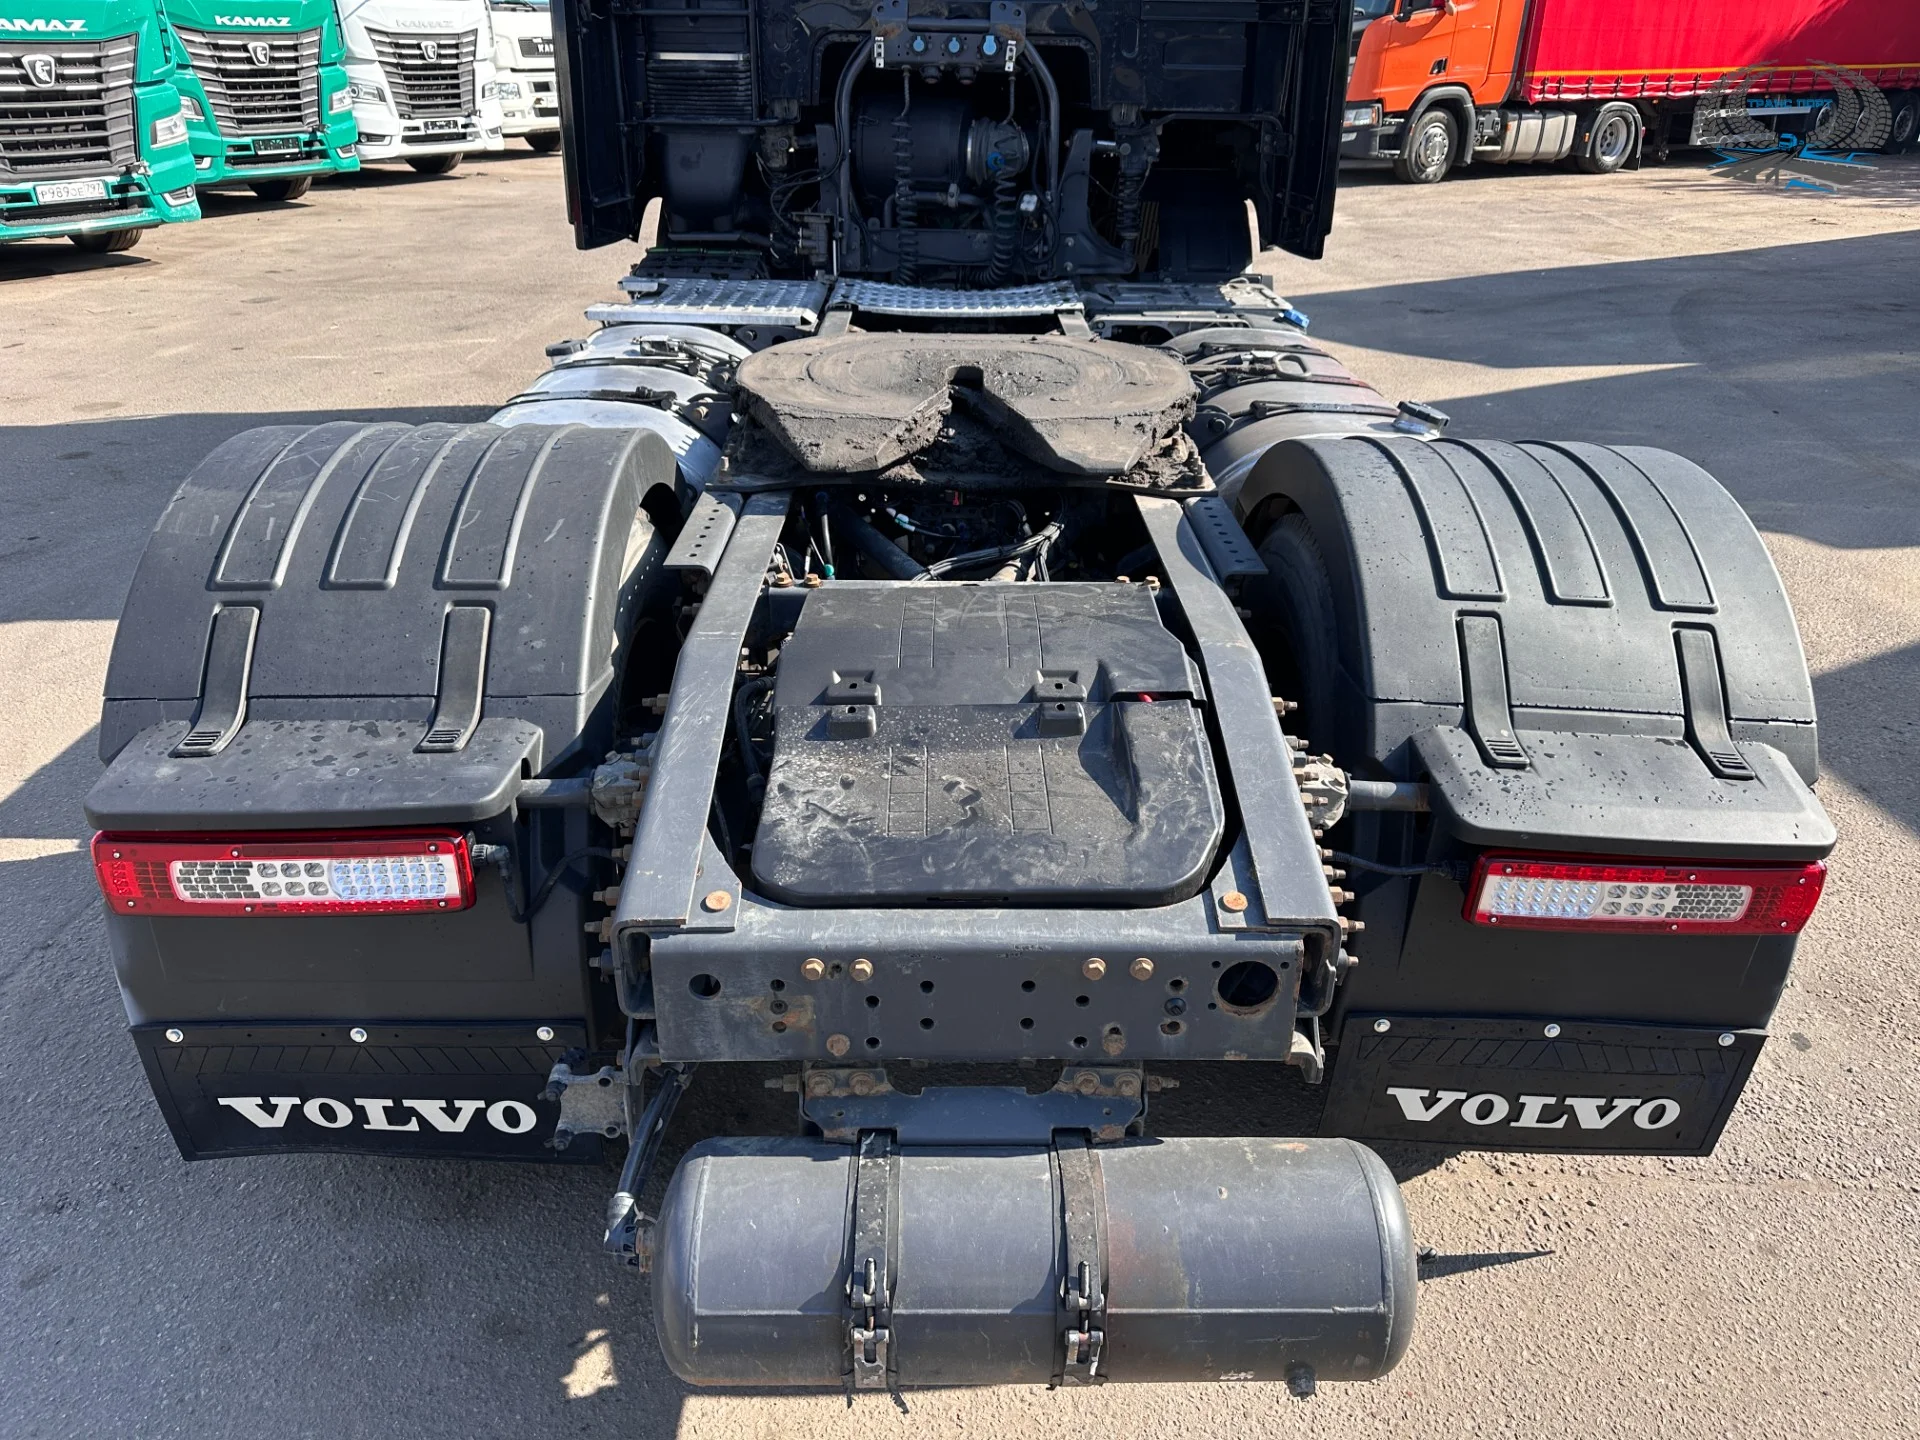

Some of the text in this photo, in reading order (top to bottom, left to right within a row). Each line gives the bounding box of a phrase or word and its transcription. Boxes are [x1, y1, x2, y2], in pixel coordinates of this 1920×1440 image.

[0, 18, 88, 31] AMAZ
[214, 15, 292, 27] KAMAZ
[395, 18, 454, 29] KAMAZ
[1386, 1086, 1681, 1130] VOLVO
[217, 1096, 538, 1134] VOLVO
